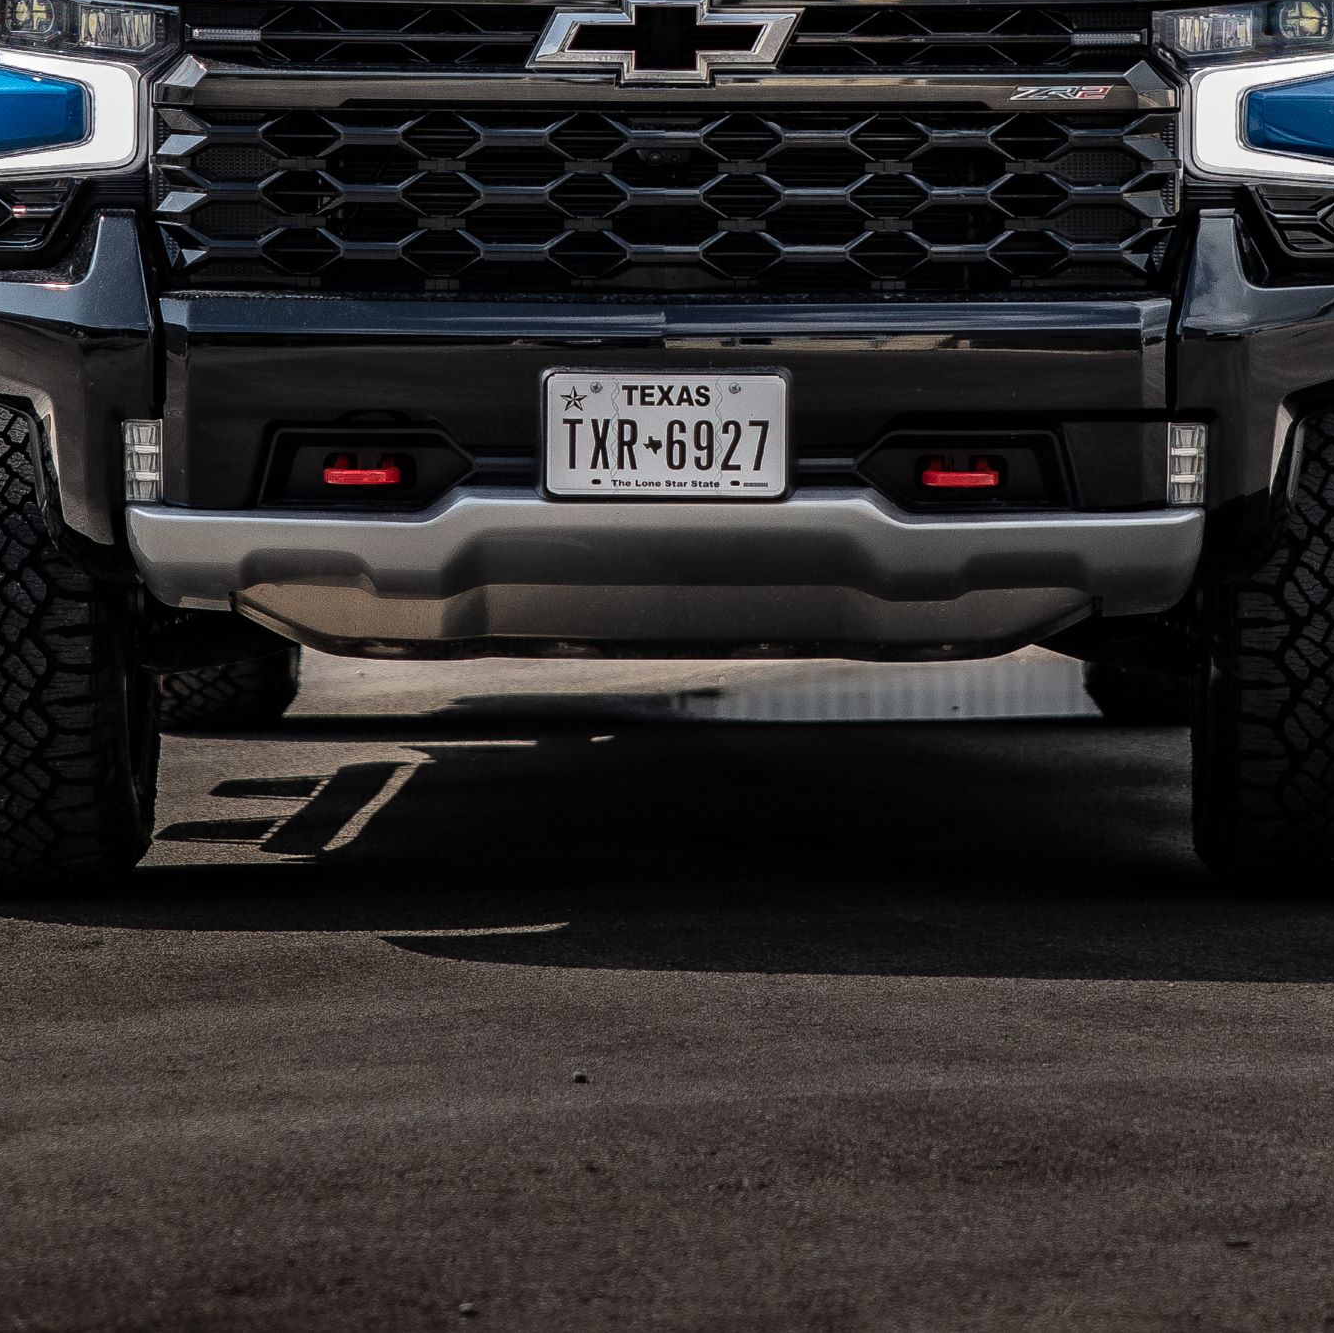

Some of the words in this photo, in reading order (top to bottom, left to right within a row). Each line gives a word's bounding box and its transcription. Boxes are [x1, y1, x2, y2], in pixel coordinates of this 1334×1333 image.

[1009, 85, 1114, 100] ZR2
[622, 385, 711, 406] TEXAS
[563, 418, 638, 470] TXR
[666, 420, 769, 471] 6927
[611, 479, 632, 488] The
[635, 479, 661, 488] Lone
[665, 479, 688, 488] Star
[691, 479, 720, 488] State
